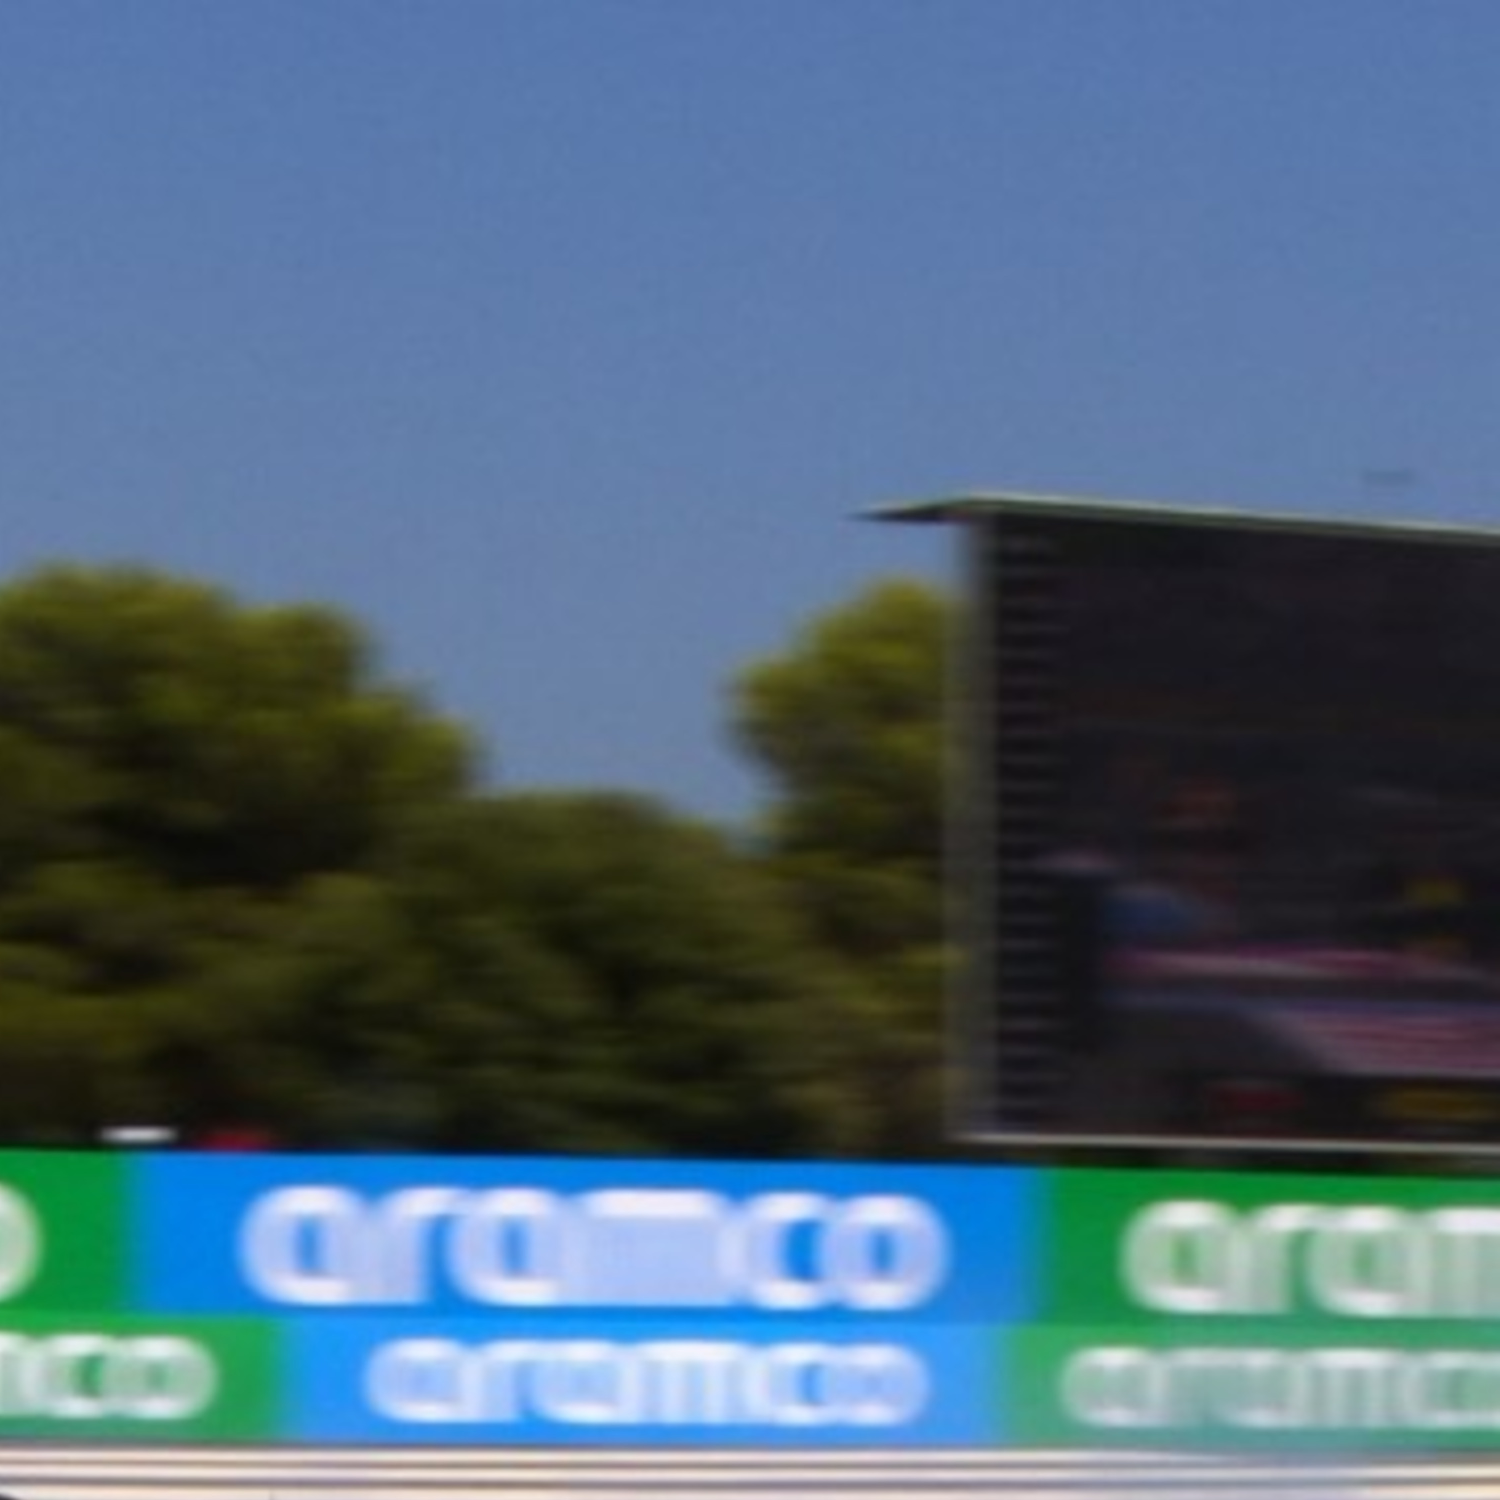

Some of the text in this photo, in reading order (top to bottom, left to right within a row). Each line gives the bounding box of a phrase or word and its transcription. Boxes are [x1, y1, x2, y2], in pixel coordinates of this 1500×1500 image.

[237, 1184, 950, 1310] aramco
[364, 1338, 931, 1426] aramco
[1062, 1346, 1500, 1430] aramc
